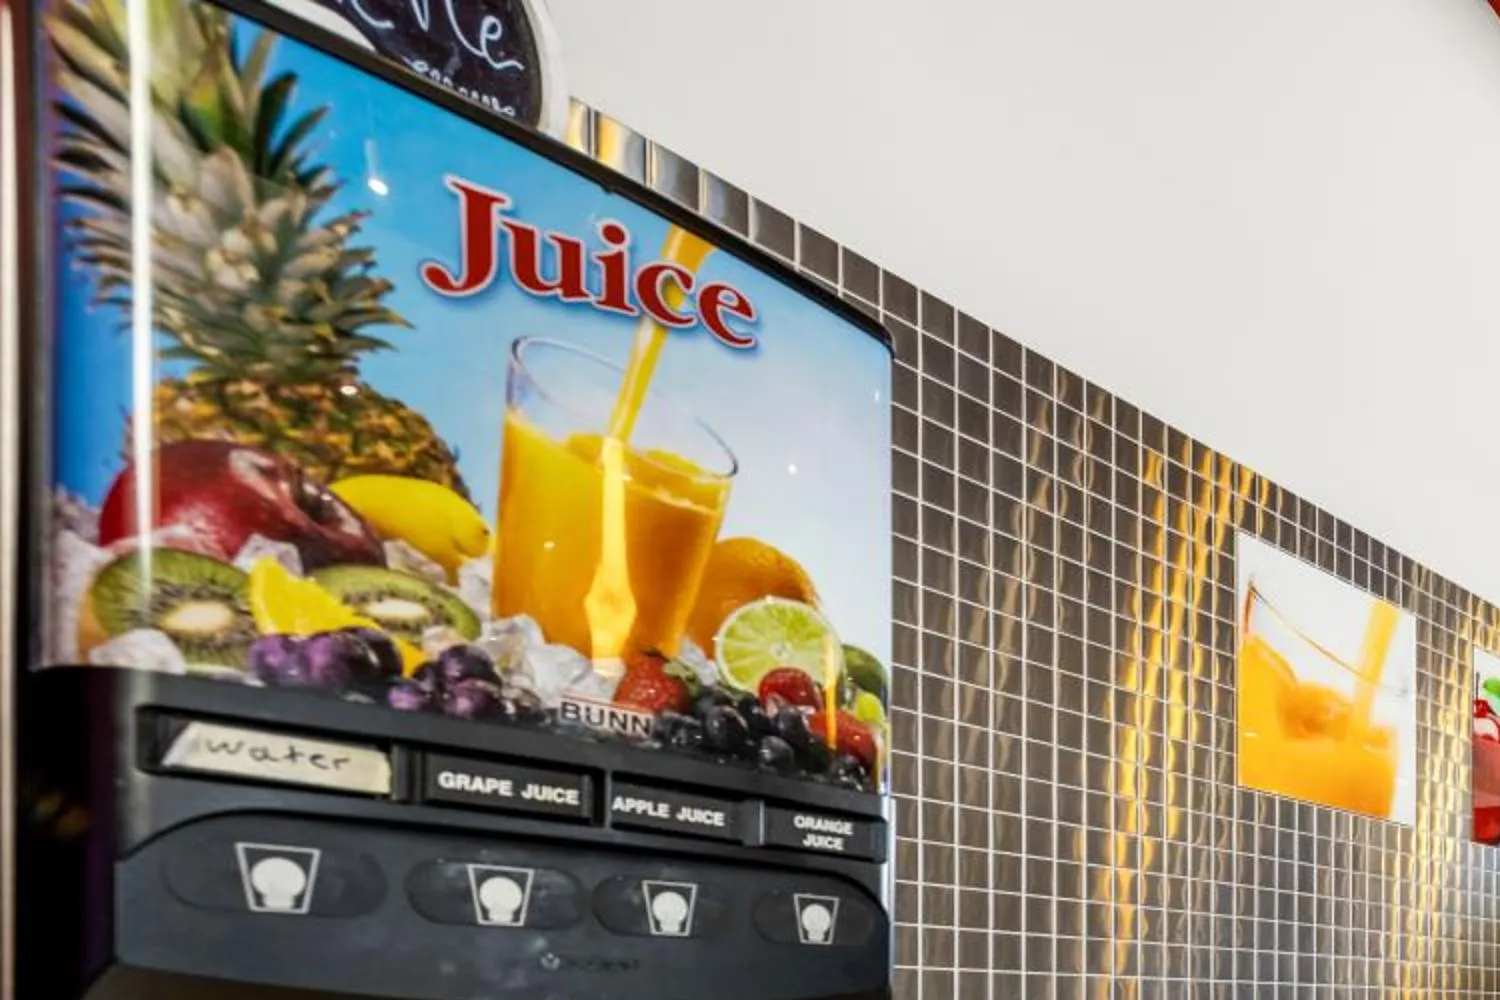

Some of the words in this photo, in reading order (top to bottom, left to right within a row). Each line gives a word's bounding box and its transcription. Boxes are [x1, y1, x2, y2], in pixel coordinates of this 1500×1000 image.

[421, 174, 757, 348] Juice
[561, 700, 652, 737] BUNN
[438, 770, 513, 797] GRAPE
[520, 783, 580, 805] JUICE
[611, 795, 670, 819] APPLE
[675, 805, 725, 827] JUICE
[793, 815, 854, 836] ORANGE
[801, 832, 844, 852] JUICE
